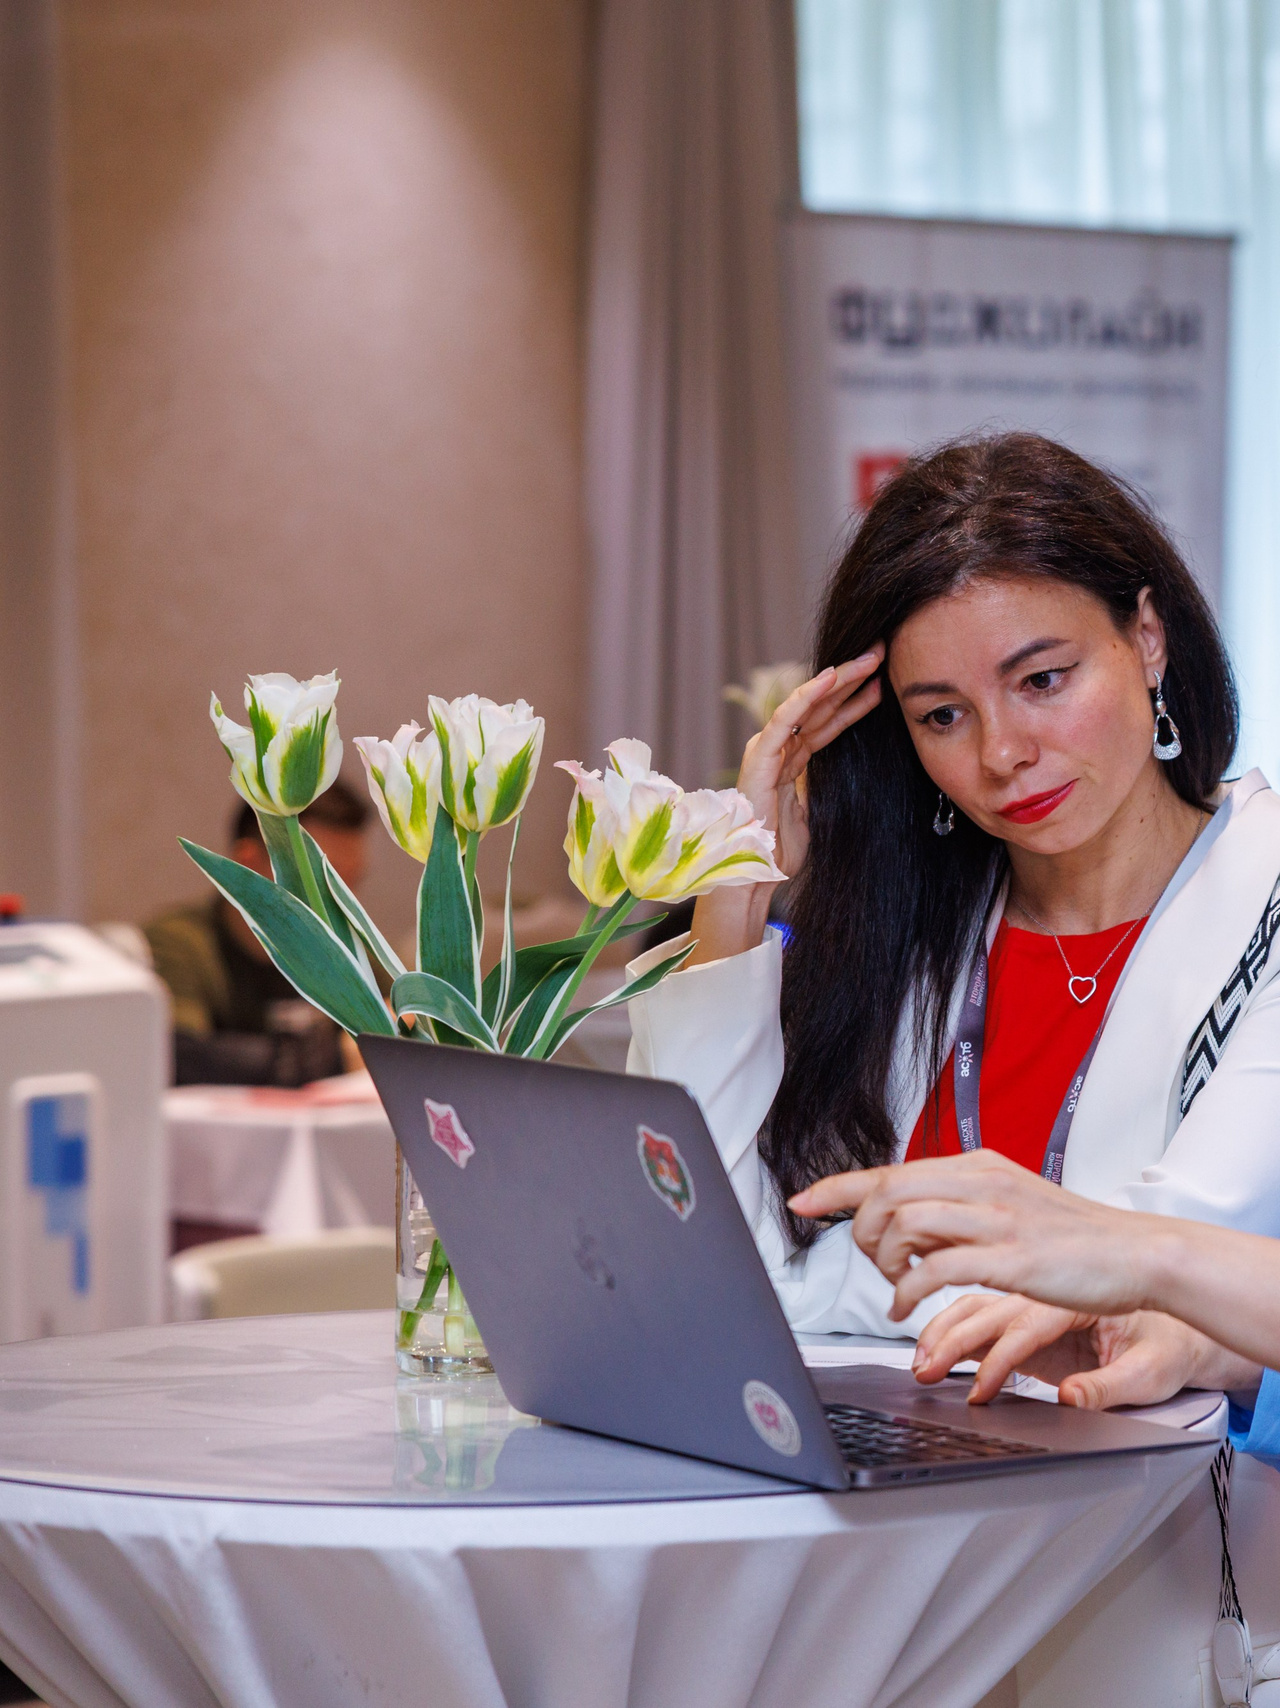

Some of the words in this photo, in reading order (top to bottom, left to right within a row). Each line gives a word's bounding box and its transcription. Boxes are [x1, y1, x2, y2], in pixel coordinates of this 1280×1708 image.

[969, 975, 982, 1005] ВТОРОЙ
[960, 1118, 970, 1142] АСХТБ
[1051, 1153, 1063, 1183] ВТОРОЙ
